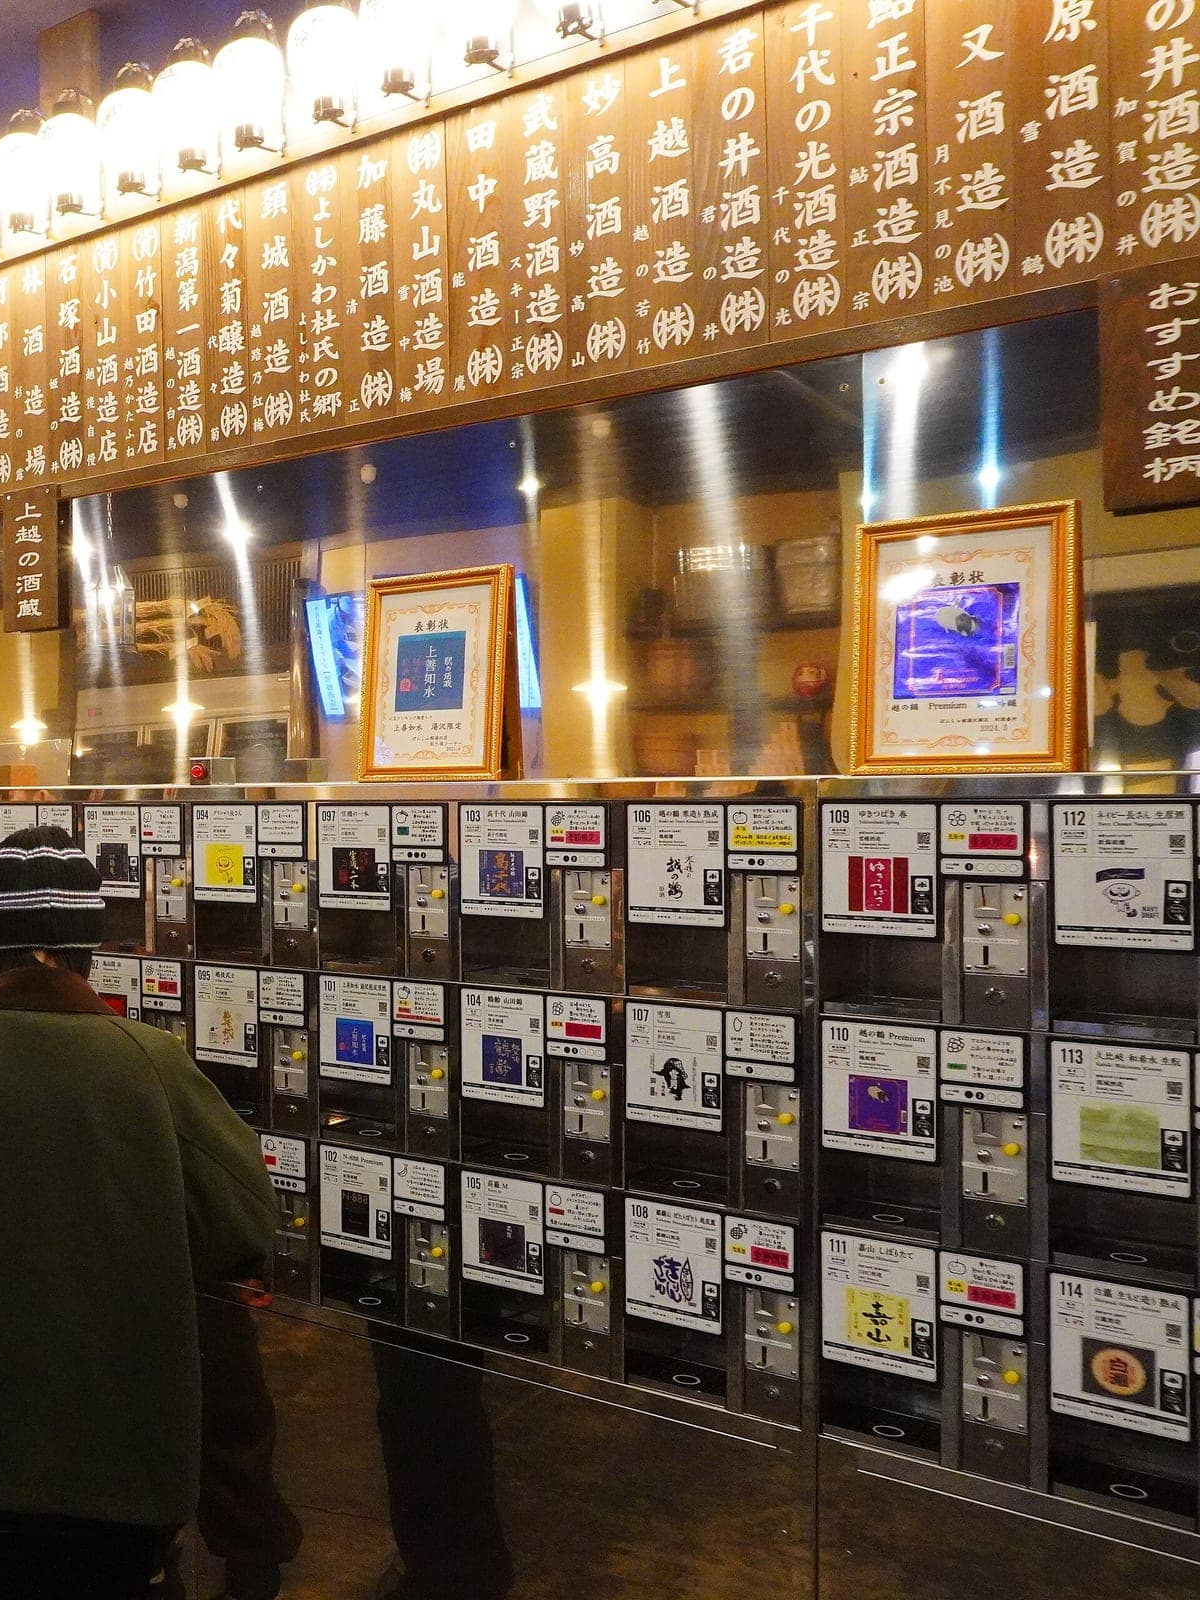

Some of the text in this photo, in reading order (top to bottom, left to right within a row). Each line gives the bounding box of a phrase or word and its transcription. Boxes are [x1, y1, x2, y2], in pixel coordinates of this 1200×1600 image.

[580, 73, 627, 363] 妙高酒造(株)
[648, 57, 695, 350] 上越酒造(株)
[716, 27, 766, 336] 君の井酒造(株)
[788, 2, 841, 321] 千代の光酒造(株)
[932, 143, 955, 297] 月不見の池
[1019, 119, 1045, 277] 雪鶴
[1112, 96, 1141, 257] 加賀の井
[356, 153, 393, 409] 加藤酒造(株)
[407, 131, 446, 396] (株)丸山酒造場
[464, 120, 503, 387] 田中酒造(株)
[522, 93, 564, 375] 武蔵野酒造(株)
[632, 224, 651, 356] 越の若竹
[700, 205, 720, 343] 君の井
[771, 185, 793, 328] 千代の光
[848, 165, 872, 314] 鮎正宗
[58, 253, 84, 472] 石塚酒造(株)
[173, 212, 203, 447] 新潟第一酒造(株)
[216, 198, 248, 439] 代々菊醸造(株)
[345, 299, 361, 413] 清正
[397, 284, 413, 403] 雪中梅
[451, 271, 467, 393] 能鷹
[509, 256, 525, 380] スキー正宗
[568, 239, 586, 368] 妙高山
[1142, 282, 1200, 484] おすすめ銘柄
[14, 502, 43, 619] 上越の酒蔵
[414, 619, 449, 632] 表彰状
[423, 645, 437, 698] 上善如水
[928, 701, 967, 710] Premium
[196, 809, 209, 820] 094
[322, 810, 336, 822] 097
[466, 810, 481, 822] 103
[634, 810, 651, 823] 106
[829, 809, 850, 824] 109
[859, 810, 896, 818] ゆきつばき
[1063, 811, 1086, 826] 112
[324, 980, 336, 992] 101
[466, 994, 481, 1007] 104
[632, 1008, 649, 1022] 107
[830, 1027, 849, 1042] 110
[859, 1029, 926, 1043] 越の鶴 Premium
[1061, 1048, 1083, 1064] 113
[324, 1150, 338, 1163] 102
[466, 1177, 481, 1190] 105
[632, 1204, 649, 1219] 108
[829, 1238, 847, 1255] 111
[1060, 1281, 1083, 1298] 114
